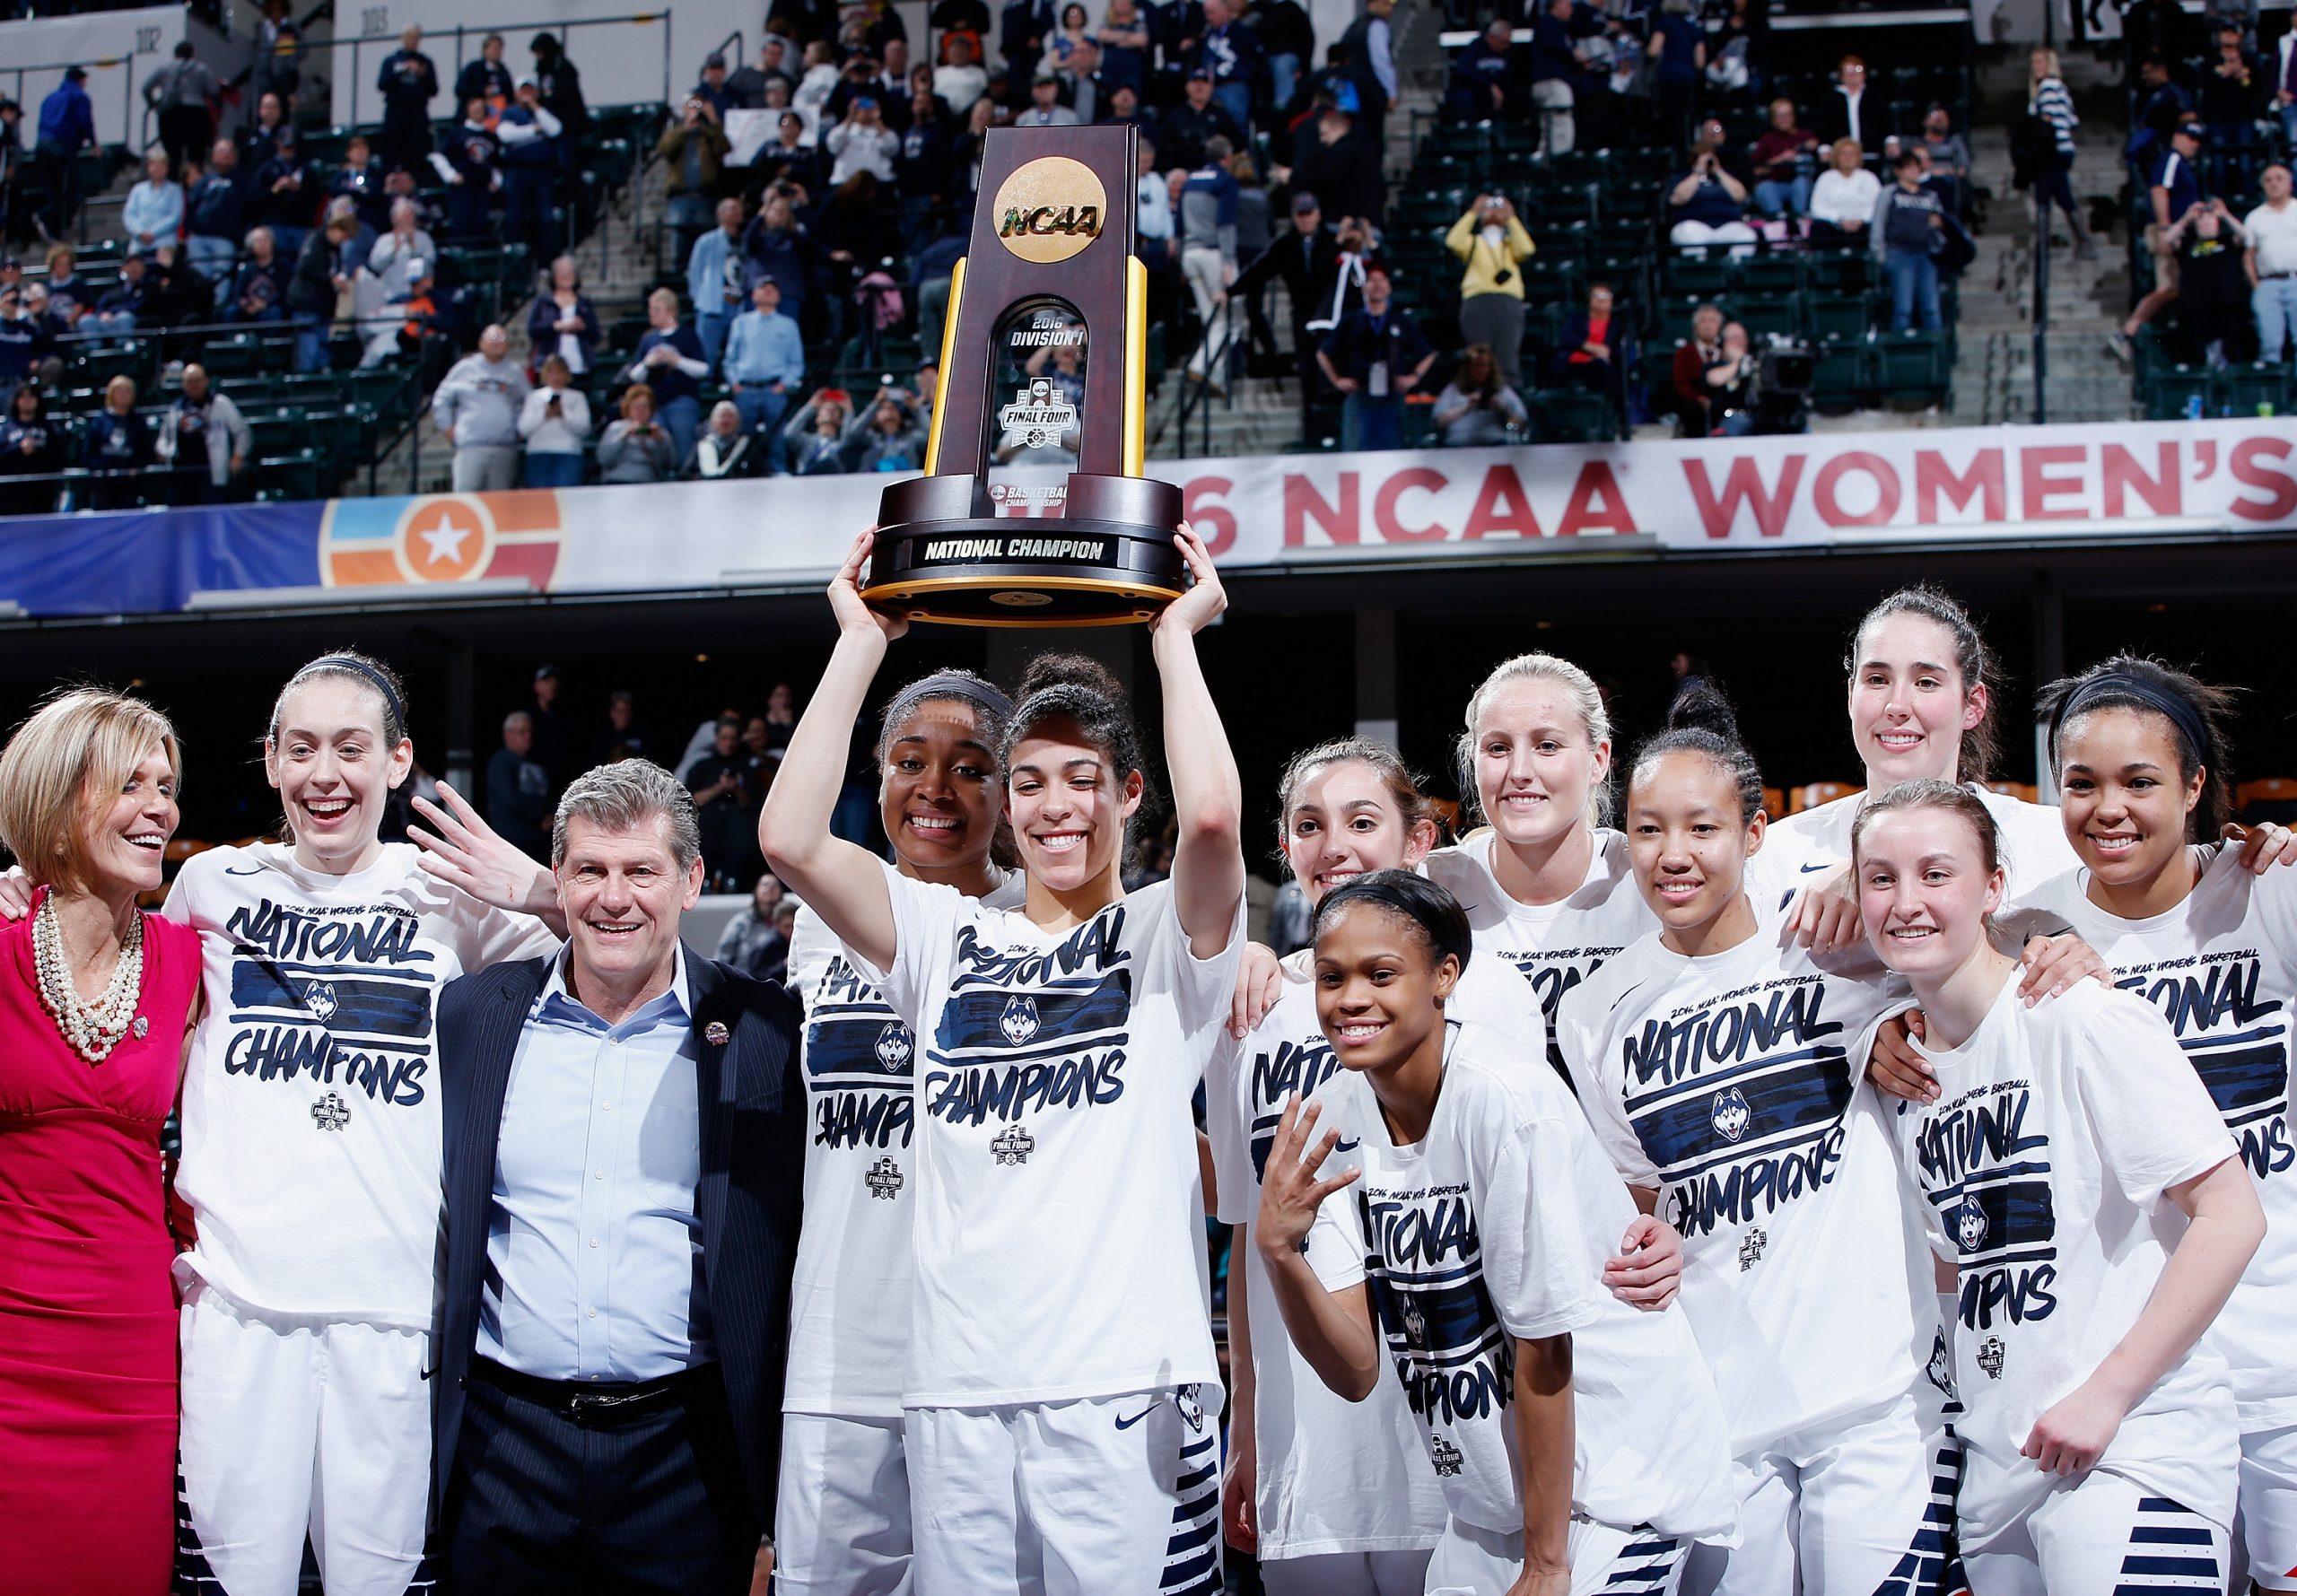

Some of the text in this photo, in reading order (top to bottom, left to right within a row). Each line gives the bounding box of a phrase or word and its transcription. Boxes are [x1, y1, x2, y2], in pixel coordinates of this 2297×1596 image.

[135, 25, 162, 55] 102
[1000, 205, 1101, 238] NCAA
[1032, 317, 1063, 329] 2016
[1010, 332, 1076, 346] DIVISION
[1006, 412, 1070, 423] FINAL FOUR
[1681, 436, 2296, 540] WOMEN'S
[1005, 499, 1062, 507] CHAMPIONSHIP
[924, 538, 1105, 561] NATIONAL CHAMPION
[368, 904, 419, 919] BASKETBALL
[225, 898, 435, 964] NATIONAL
[1007, 944, 1028, 954] 2016
[2199, 947, 2260, 965] BASKETBALL
[1671, 1005, 1694, 1020] 2016
[1763, 973, 1824, 991] BASKETBALL
[1622, 982, 1845, 1097] NATIONAL
[926, 1049, 1127, 1128] CHAMPIONS
[1012, 1140, 1032, 1149] FOUR
[868, 1175, 886, 1184] FINAL
[886, 1177, 901, 1185] FOUR
[1368, 1188, 1388, 1197] 2016
[1980, 1357, 1998, 1366] FINAL
[1442, 1453, 1460, 1463] FOUR
